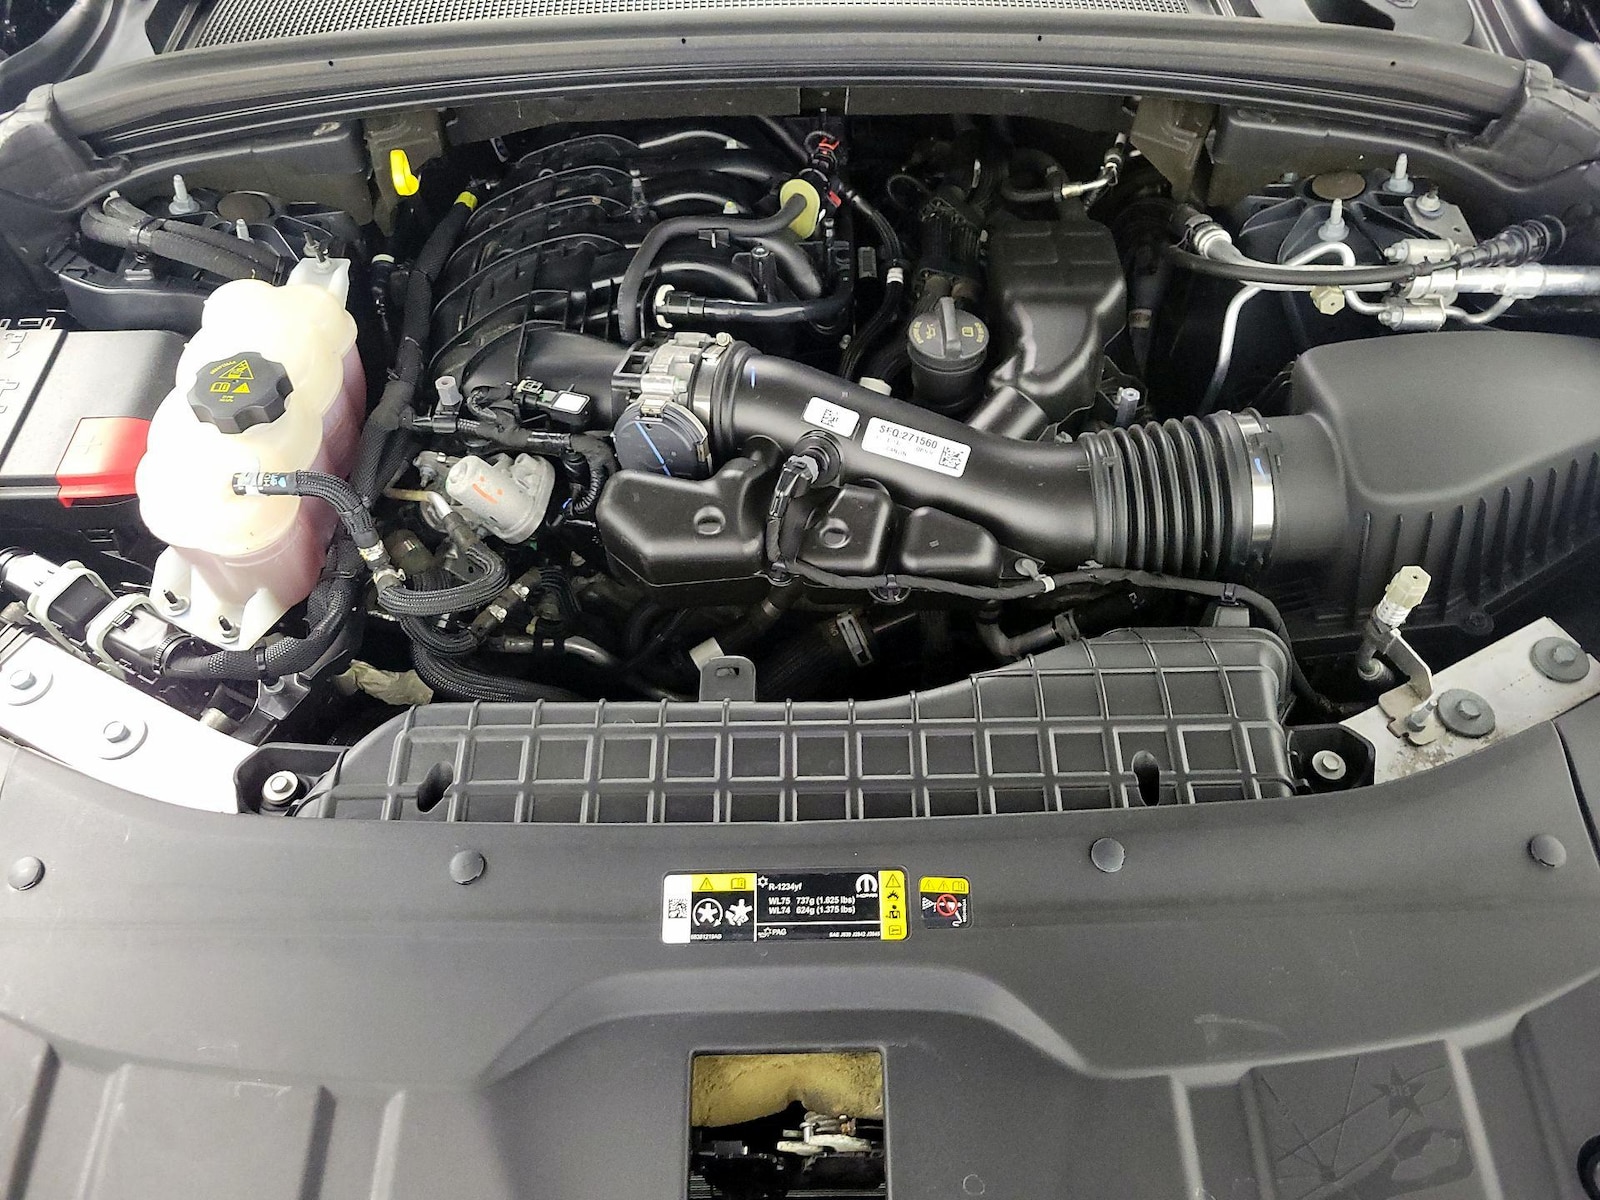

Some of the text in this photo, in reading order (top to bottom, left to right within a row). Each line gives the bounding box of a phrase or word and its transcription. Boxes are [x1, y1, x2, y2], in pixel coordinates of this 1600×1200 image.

[768, 882, 803, 892] R-1234yf
[768, 895, 856, 906] WL75 737g (1.625 lbs)
[768, 905, 856, 915] WL74 624g (1.375 lbs)
[772, 928, 787, 937] PAG
